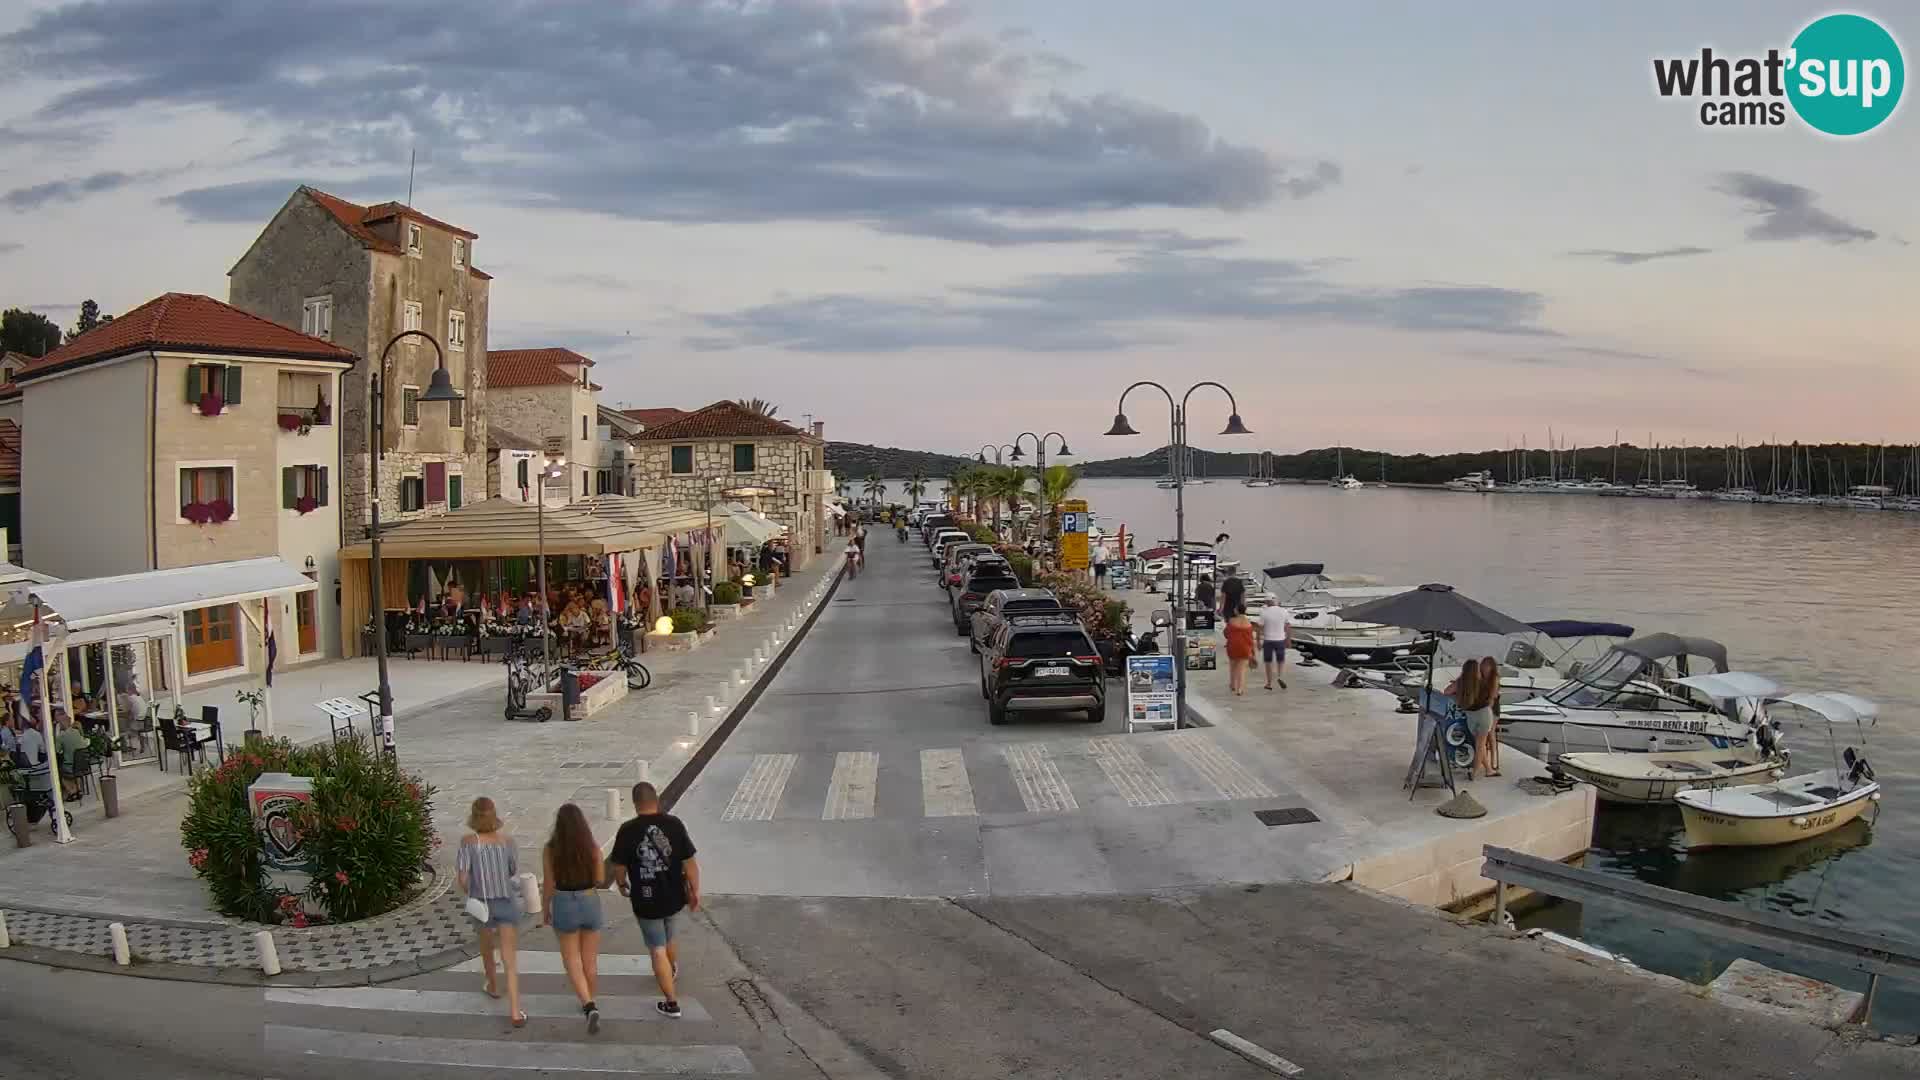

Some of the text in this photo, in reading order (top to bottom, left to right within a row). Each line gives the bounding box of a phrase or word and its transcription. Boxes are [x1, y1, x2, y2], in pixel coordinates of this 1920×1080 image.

[1064, 514, 1076, 530] P
[1662, 720, 1683, 730] RENT
[1689, 721, 1708, 732] BOAT
